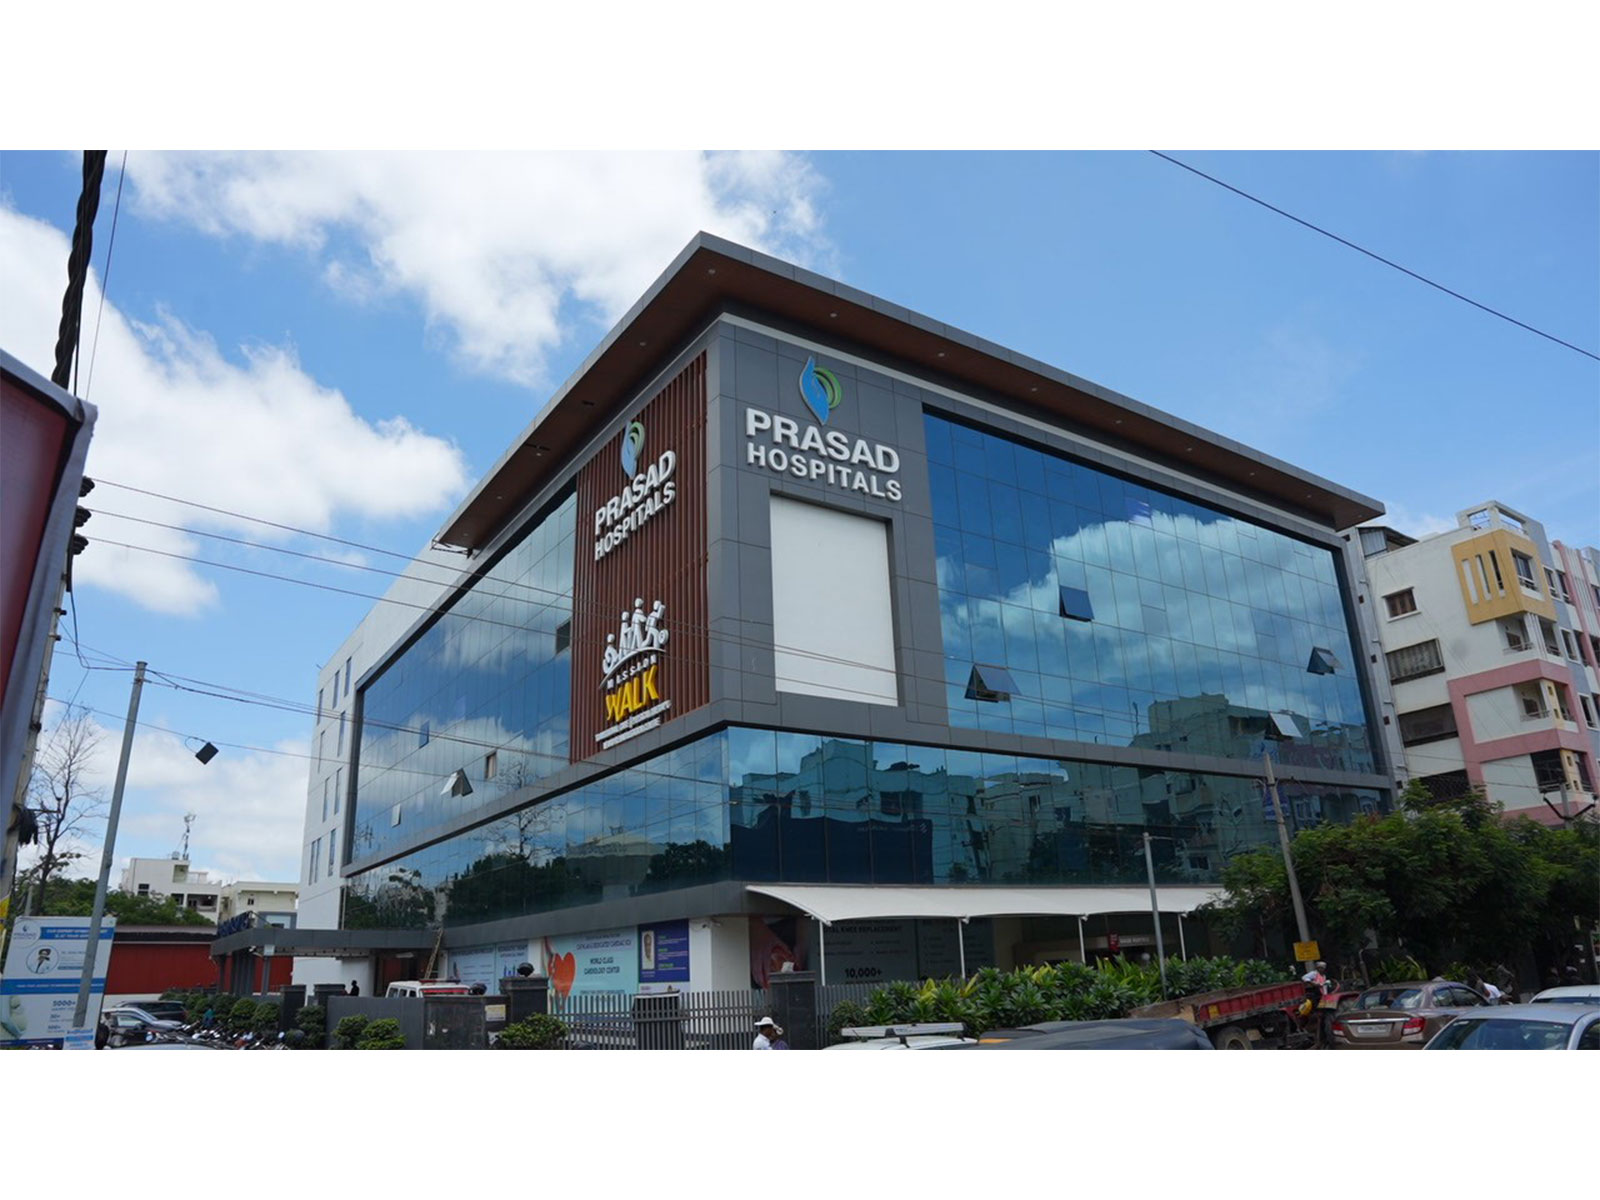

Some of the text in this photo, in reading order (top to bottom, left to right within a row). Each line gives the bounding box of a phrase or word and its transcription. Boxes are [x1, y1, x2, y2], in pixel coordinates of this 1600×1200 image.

[746, 407, 901, 474] PRASAD
[595, 450, 676, 536] PRASAD
[747, 442, 903, 502] HOSPITALS
[595, 481, 676, 561] HOSPITALS
[606, 665, 659, 722] WALK
[607, 654, 657, 690] MISSION
[845, 967, 883, 979] 10,000+
